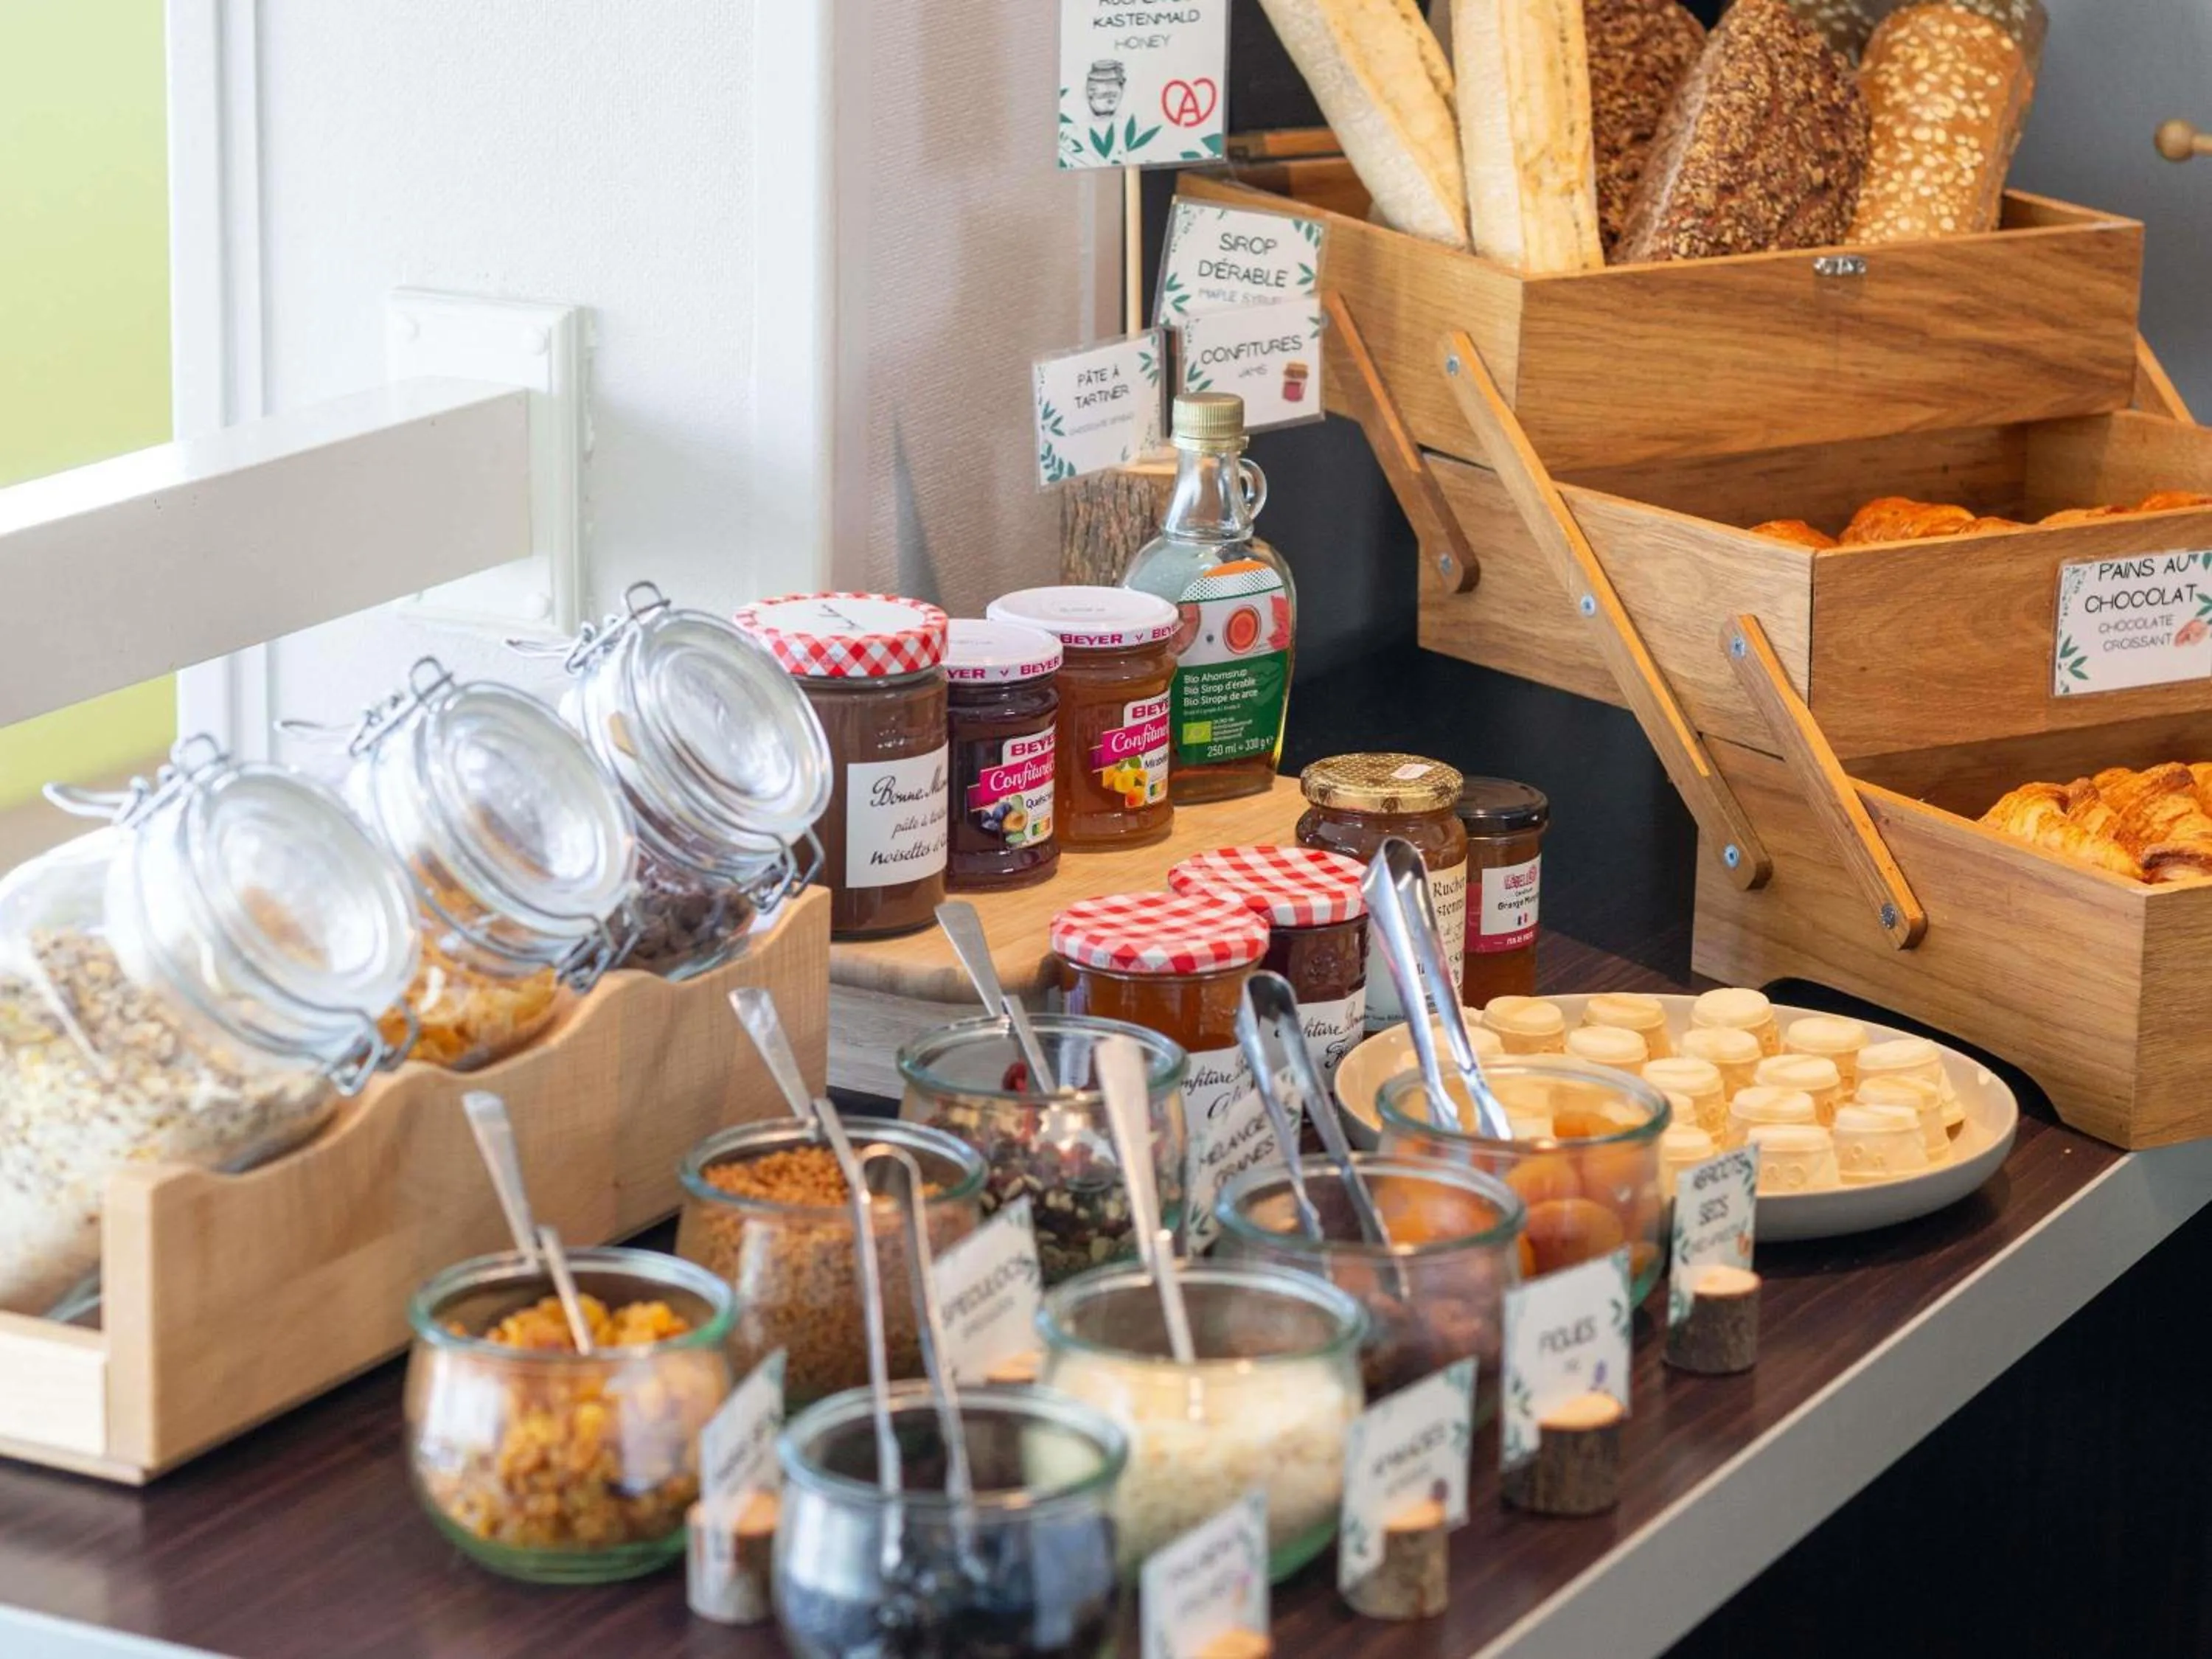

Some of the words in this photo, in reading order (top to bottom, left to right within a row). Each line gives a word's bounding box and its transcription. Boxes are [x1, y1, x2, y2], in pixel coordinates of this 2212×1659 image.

[1114, 34, 1171, 51] HONEY
[1220, 233, 1278, 255] SIROP
[1200, 335, 1303, 365] CONFITURES
[1074, 384, 1130, 409] TARTINER
[2098, 559, 2156, 582] PAINS
[2163, 554, 2191, 574] AU
[2084, 583, 2198, 613] CHOCOLAT
[2098, 614, 2175, 634] CHOCOLATE
[1060, 633, 1123, 646] BEYER
[2103, 633, 2173, 653] CROISSANT
[947, 668, 986, 679] YER
[1020, 655, 1060, 675] BEYER
[1183, 673, 1200, 684] Bio
[1183, 684, 1200, 695] Bio
[1201, 681, 1224, 695] Sirop
[1183, 696, 1200, 706] Bio
[1201, 692, 1228, 706] Sirope
[1229, 691, 1240, 701] de
[1133, 702, 1168, 719] BEY
[1207, 742, 1224, 758] 250
[869, 841, 931, 866] noisettes
